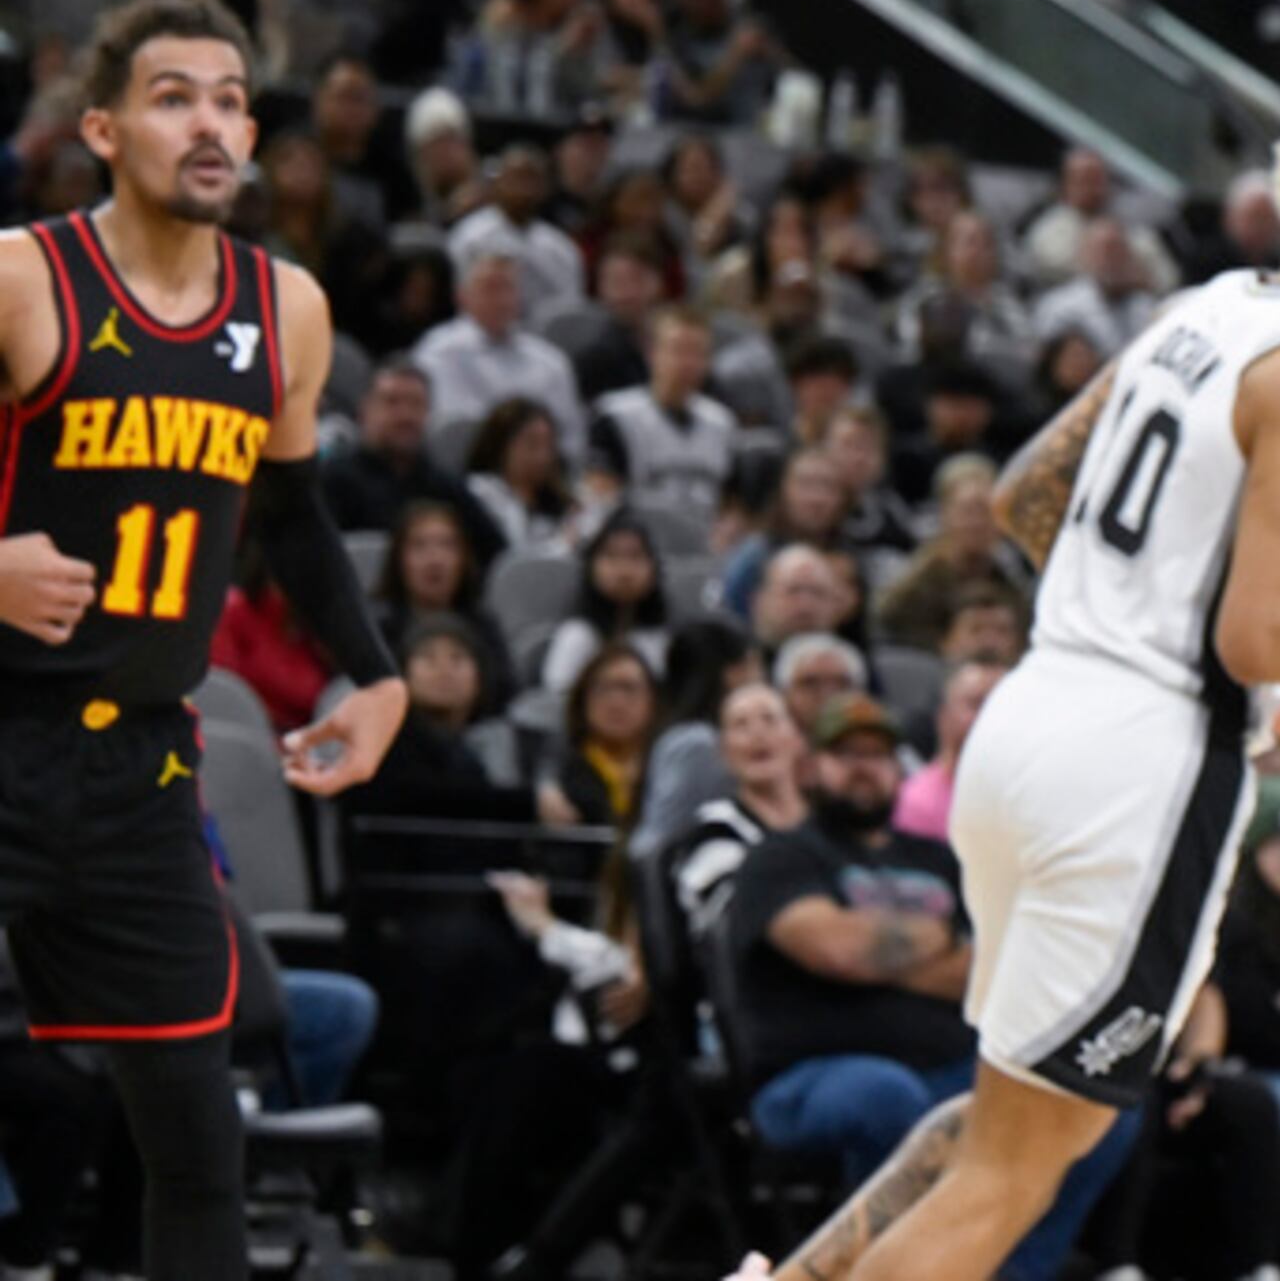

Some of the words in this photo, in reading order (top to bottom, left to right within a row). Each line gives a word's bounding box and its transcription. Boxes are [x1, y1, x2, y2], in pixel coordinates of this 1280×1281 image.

[52, 392, 270, 486] HAWKS
[1074, 384, 1182, 558] 0
[101, 503, 199, 618] 11
